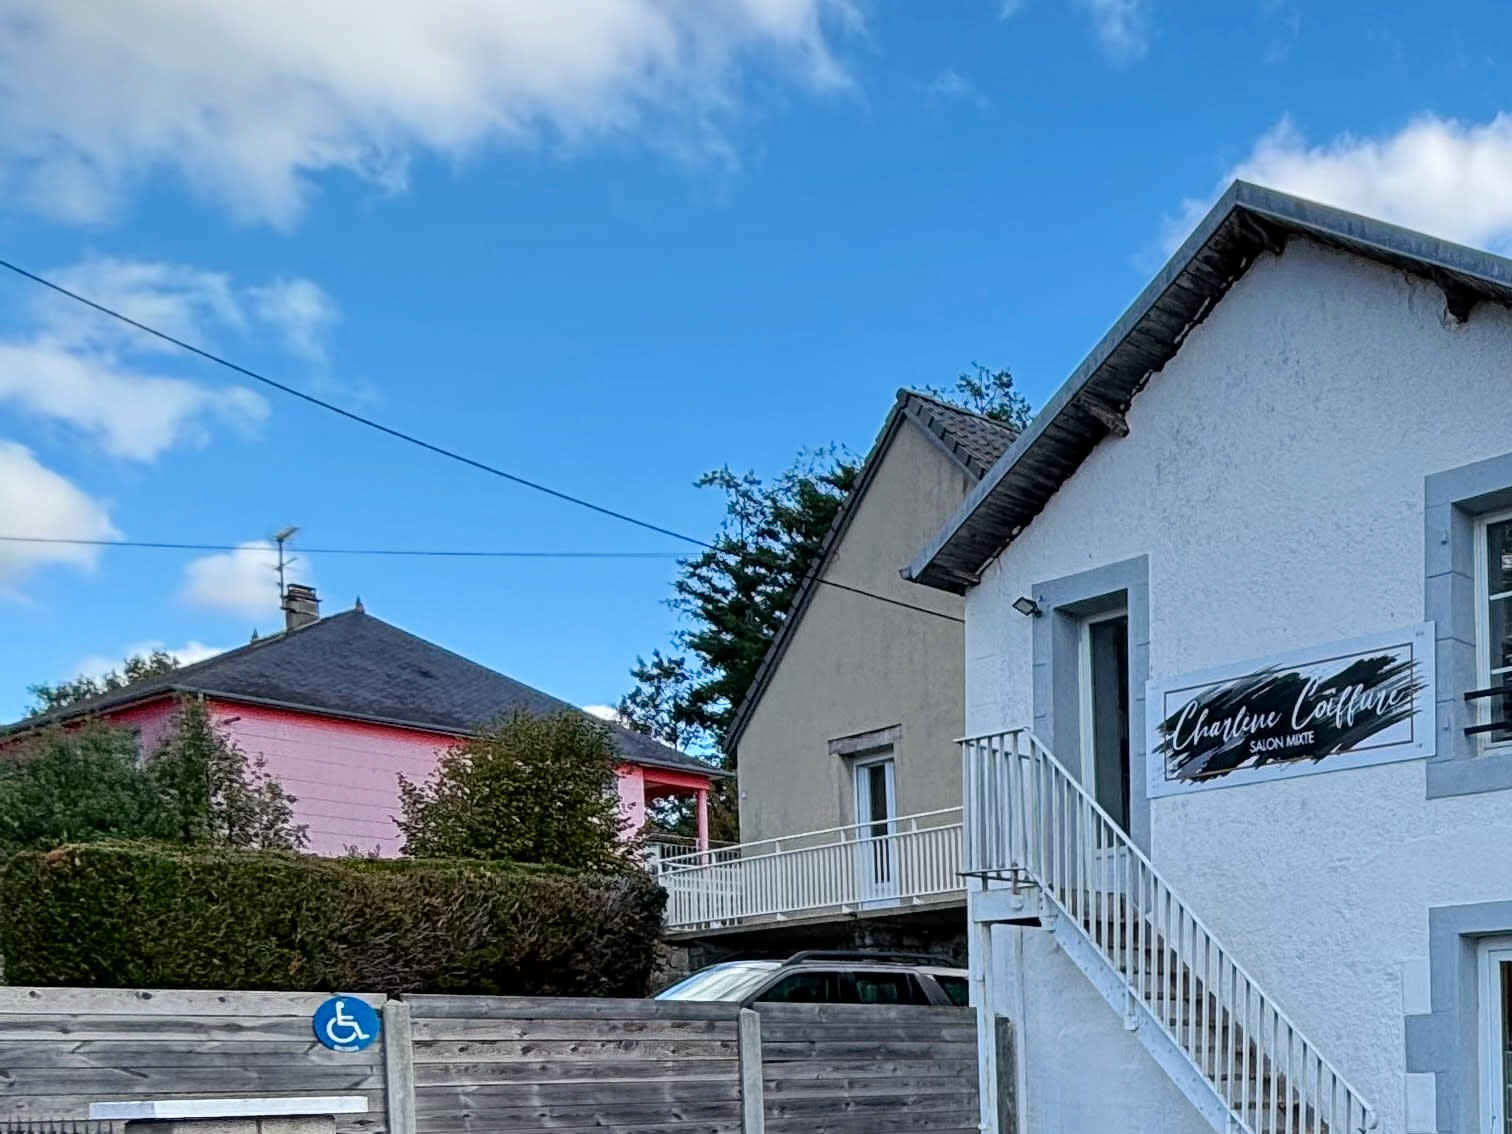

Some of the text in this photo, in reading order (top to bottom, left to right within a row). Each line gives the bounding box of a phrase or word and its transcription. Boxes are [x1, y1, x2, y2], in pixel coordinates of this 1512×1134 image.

[1292, 677, 1404, 730] Coiffure
[1250, 730, 1315, 753] SALON MIXTE
